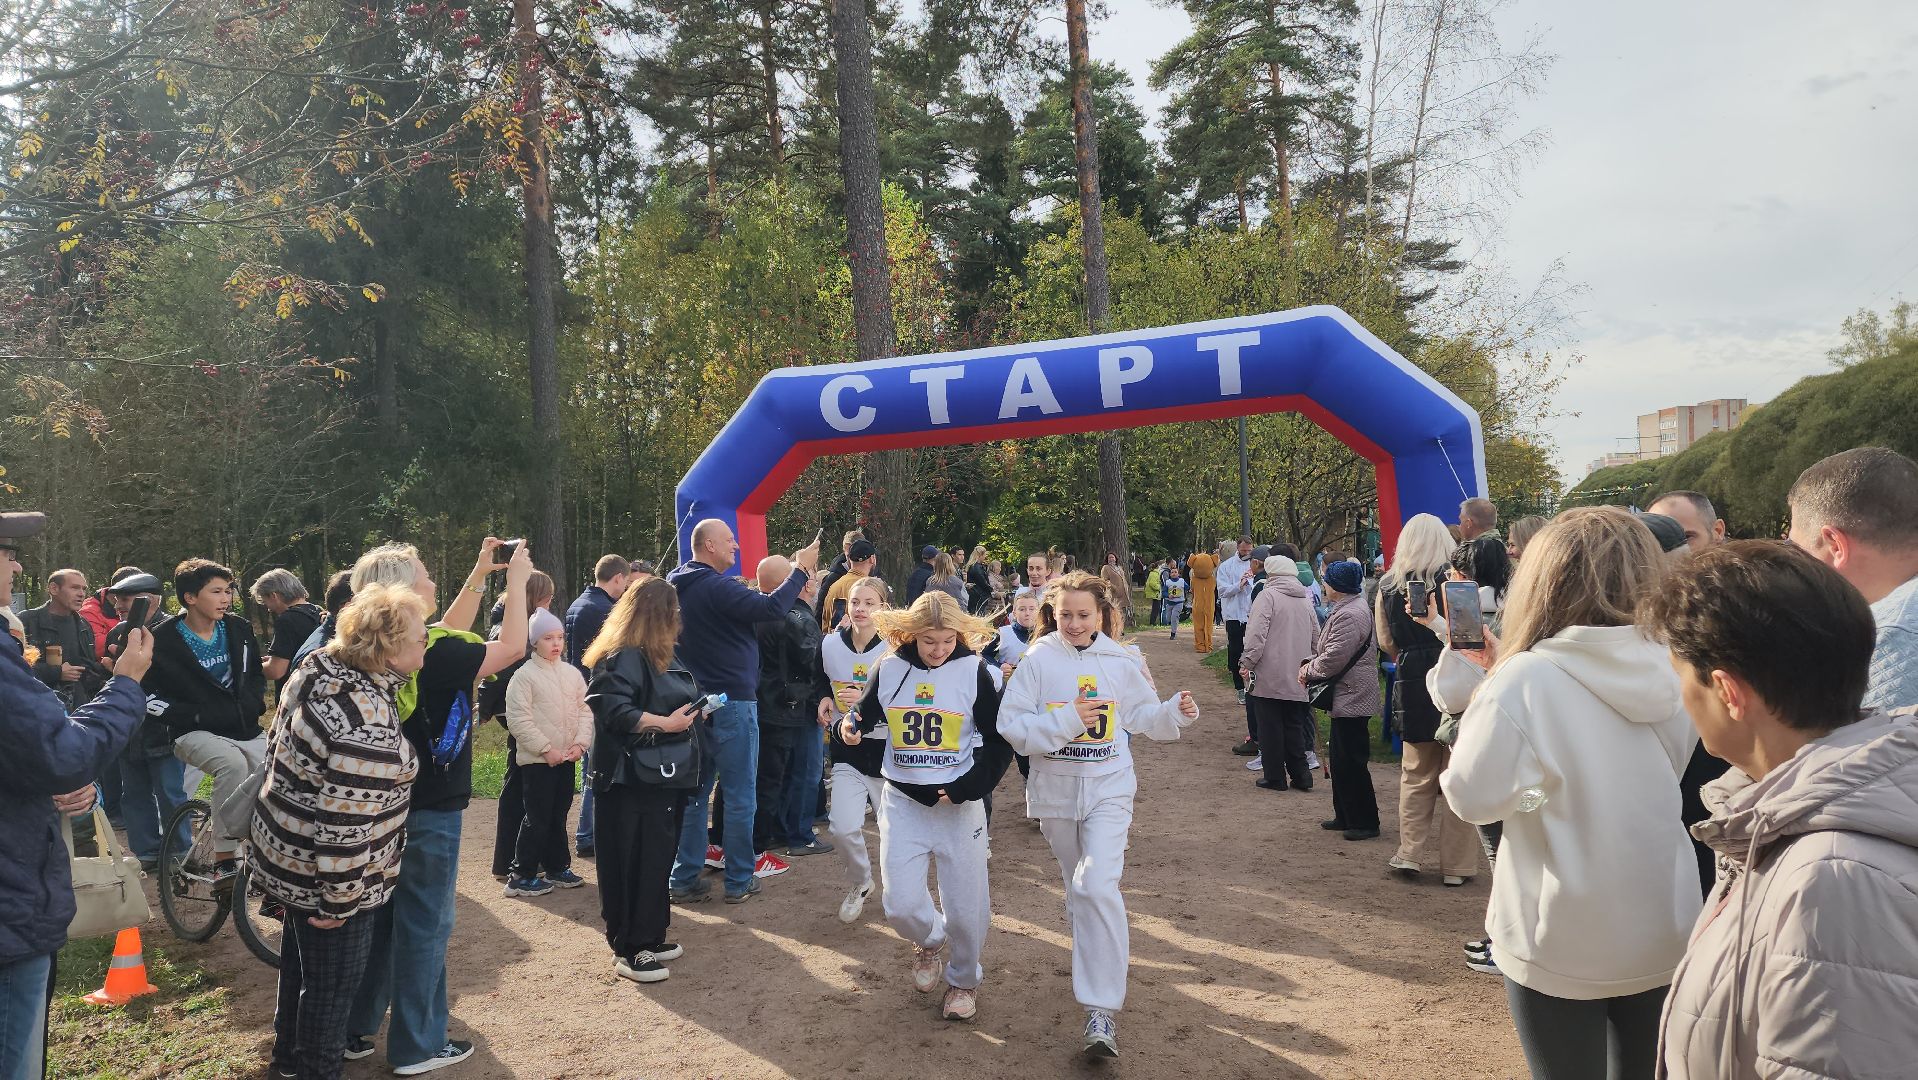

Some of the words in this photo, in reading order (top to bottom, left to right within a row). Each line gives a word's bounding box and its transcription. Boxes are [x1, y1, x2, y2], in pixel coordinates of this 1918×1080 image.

[819, 331, 1261, 432] СТАРТ
[902, 711, 943, 747] 36
[1074, 704, 1108, 740] 5
